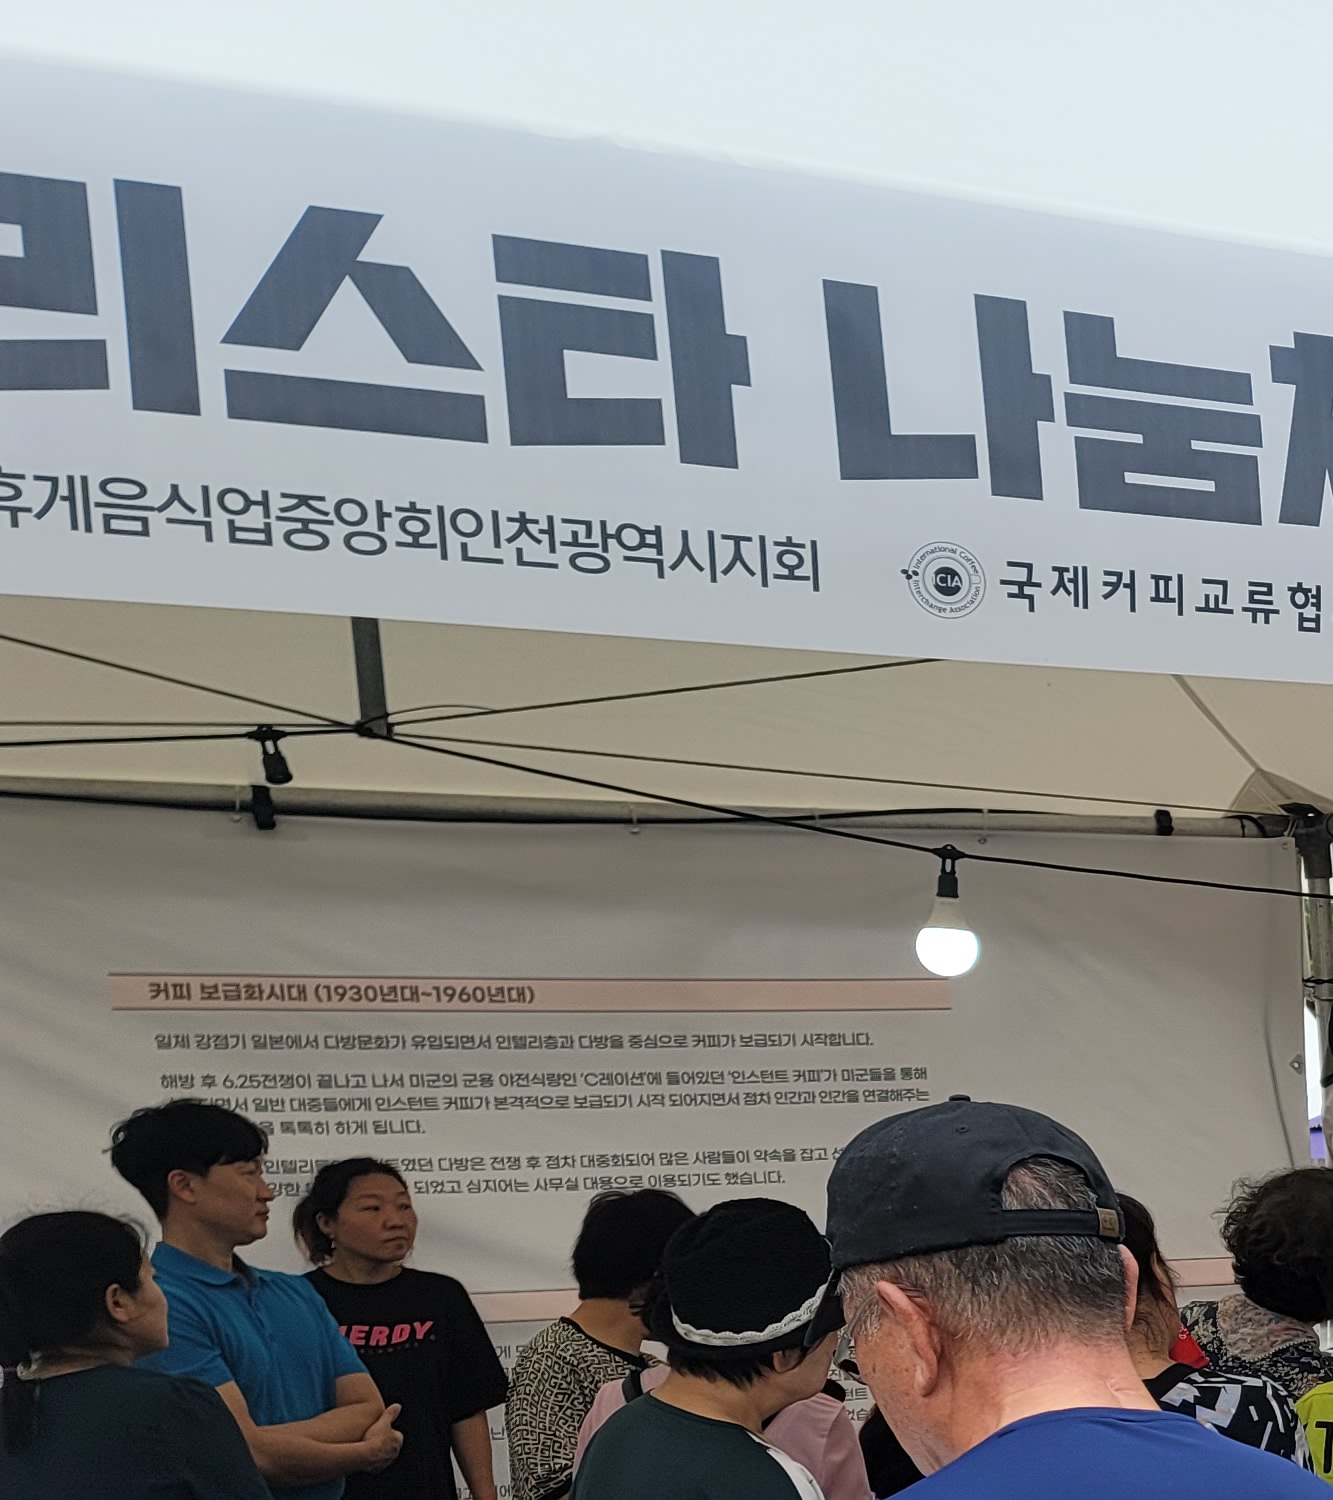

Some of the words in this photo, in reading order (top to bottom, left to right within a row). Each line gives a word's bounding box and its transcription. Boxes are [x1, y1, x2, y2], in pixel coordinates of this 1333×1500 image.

[913, 546, 957, 569] International
[959, 551, 979, 575] Coffee
[912, 580, 947, 613] Interchange
[949, 586, 981, 613] Association
[149, 982, 191, 1001] 커피
[201, 983, 307, 1002] 보급화시대
[314, 984, 535, 1004] (1930년대~1960년대)
[155, 1033, 190, 1050] 일제
[195, 1033, 247, 1050] 강점기
[251, 1033, 318, 1050] 일본에서
[324, 1034, 406, 1050] 다방문화가
[411, 1034, 491, 1051] 유입되면서
[579, 1034, 625, 1049] 다방을
[628, 1034, 689, 1049] 중심으로
[692, 1033, 736, 1049] 커피가
[739, 1033, 797, 1048] 보급되기
[800, 1032, 874, 1047] 시작합니다.
[161, 1073, 195, 1090] 해방
[201, 1073, 217, 1089] 후
[223, 1073, 312, 1090] 6.25전쟁이
[317, 1073, 368, 1089] 끝나고
[371, 1073, 405, 1088] 나서
[409, 1073, 458, 1088] 미군의
[462, 1073, 494, 1088] 군용
[499, 1072, 577, 1088] 야전식량인
[666, 1070, 726, 1086] 들어있던
[841, 1067, 897, 1082] 미군들을
[900, 1066, 928, 1081] 통해
[254, 1096, 285, 1113] 일반
[290, 1096, 371, 1112] 대중들에게
[375, 1096, 440, 1111] 인스턴트
[444, 1095, 490, 1111] 커피가
[494, 1095, 570, 1110] 본격적으로
[573, 1094, 633, 1109] 보급되기
[636, 1093, 666, 1108] 시작
[668, 1092, 740, 1107] 되어지면서
[774, 1090, 816, 1105] 인간과
[818, 1089, 859, 1104] 인간을
[862, 1088, 930, 1102] 연결해주는
[280, 1120, 329, 1136] 톡톡히
[334, 1119, 368, 1135] 하게
[372, 1119, 426, 1135] 됩니다.
[438, 1156, 486, 1171] 다방은
[490, 1155, 521, 1170] 전쟁
[525, 1155, 541, 1170] 후
[580, 1153, 655, 1168] 대중화되어
[659, 1151, 689, 1167] 많은
[693, 1150, 750, 1165] 사람들이
[753, 1148, 797, 1163] 약속을
[799, 1148, 829, 1162] 잡고
[414, 1180, 463, 1195] 되었고
[466, 1179, 530, 1194] 심지어는
[533, 1177, 579, 1192] 사무실
[583, 1175, 644, 1190] 대용으로
[648, 1173, 722, 1188] 이용되기도
[724, 1171, 786, 1186] 했습니다.
